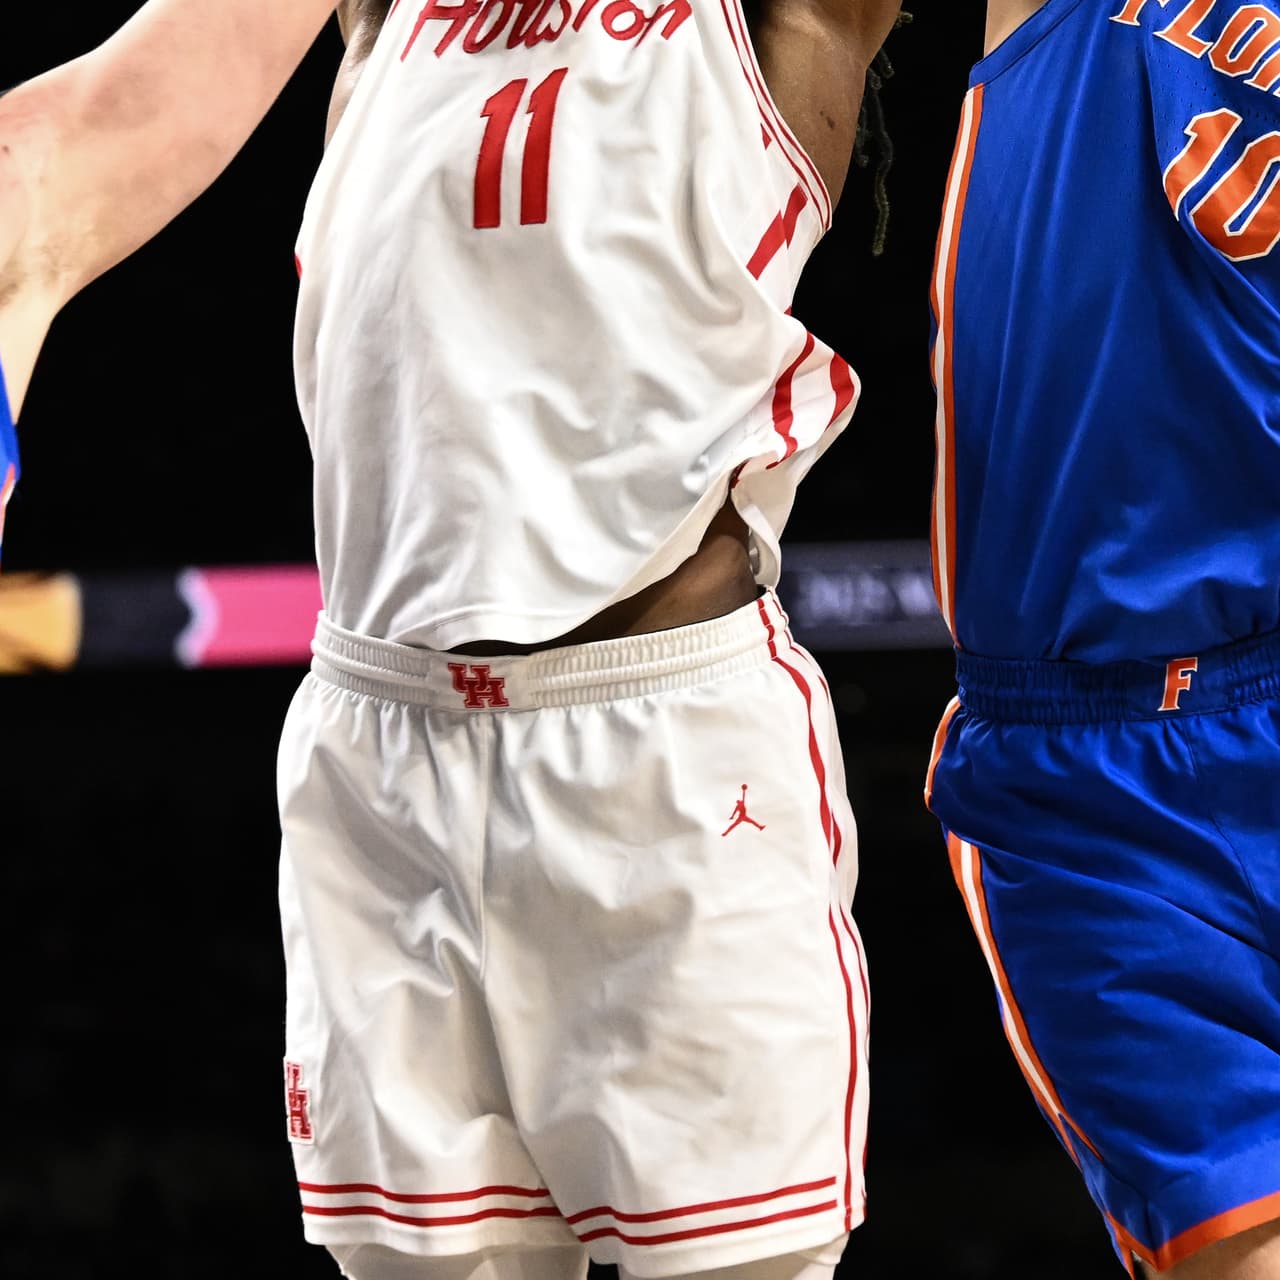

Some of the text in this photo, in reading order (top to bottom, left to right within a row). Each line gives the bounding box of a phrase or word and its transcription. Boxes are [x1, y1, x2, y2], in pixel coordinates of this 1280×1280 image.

[473, 67, 568, 229] 11
[448, 662, 509, 708] UH
[1157, 657, 1198, 711] F
